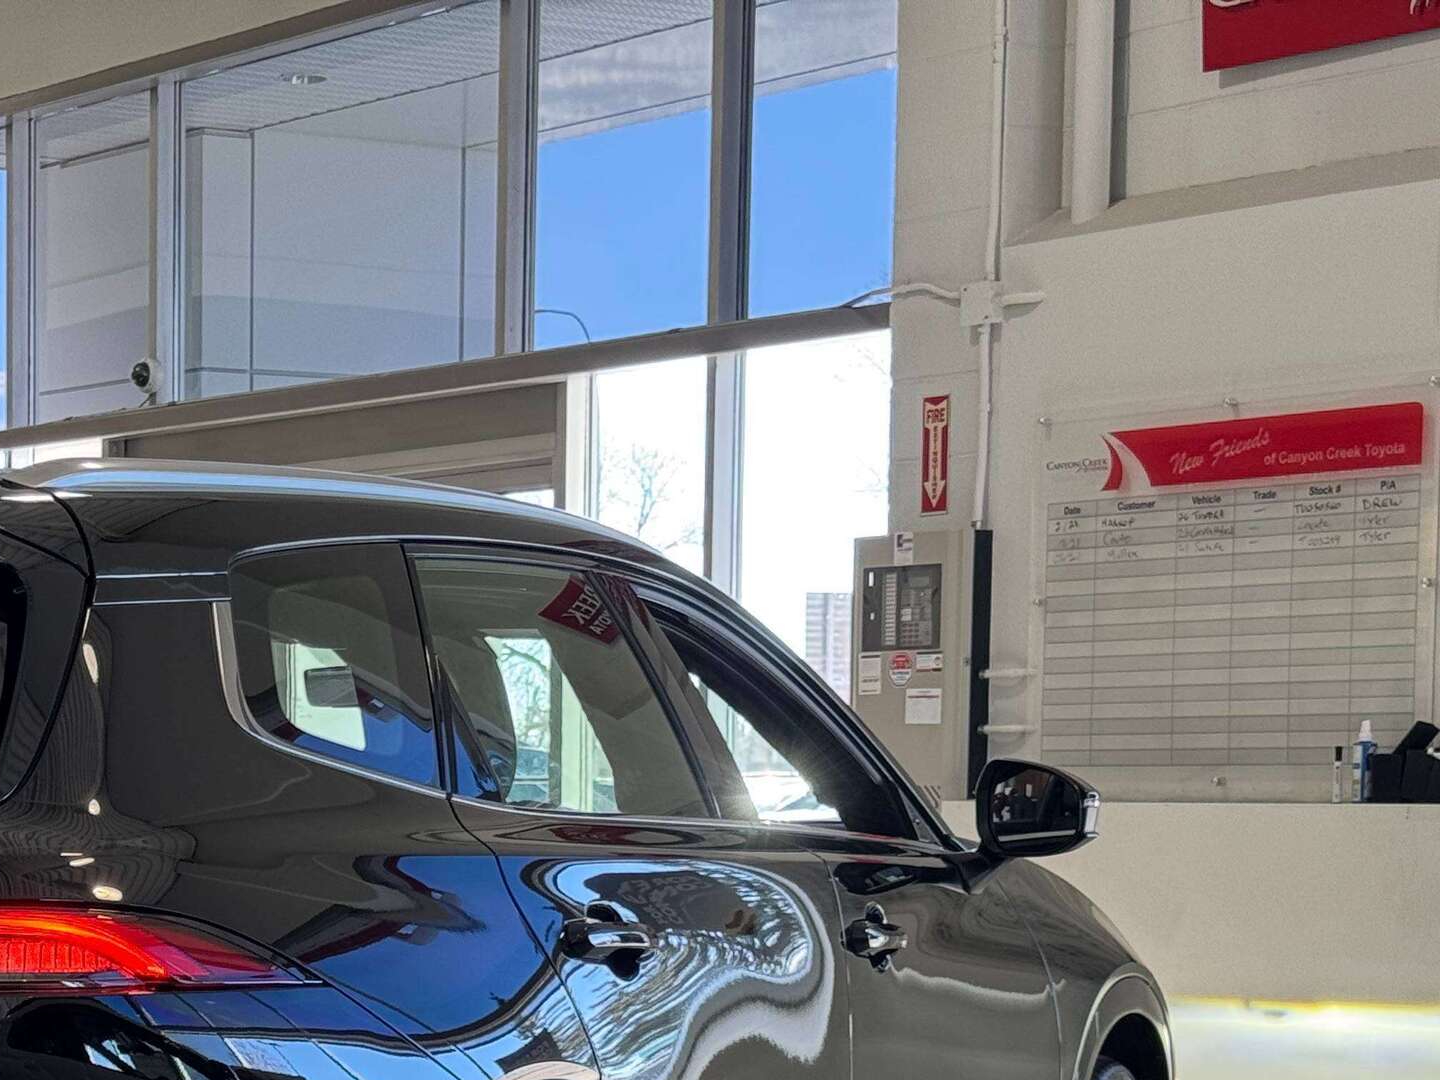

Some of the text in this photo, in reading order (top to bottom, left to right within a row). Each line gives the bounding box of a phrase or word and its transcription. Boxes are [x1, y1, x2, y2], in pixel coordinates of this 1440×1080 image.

[926, 408, 946, 423] FIRE
[1169, 427, 1271, 475] New Friends
[1263, 442, 1406, 466] of Canyon Creek Toyota
[1253, 490, 1277, 500] Trade
[1309, 485, 1333, 496] Stock
[1192, 494, 1222, 505] Vehicle
[1063, 506, 1081, 515] Date
[1117, 501, 1156, 511] Customer
